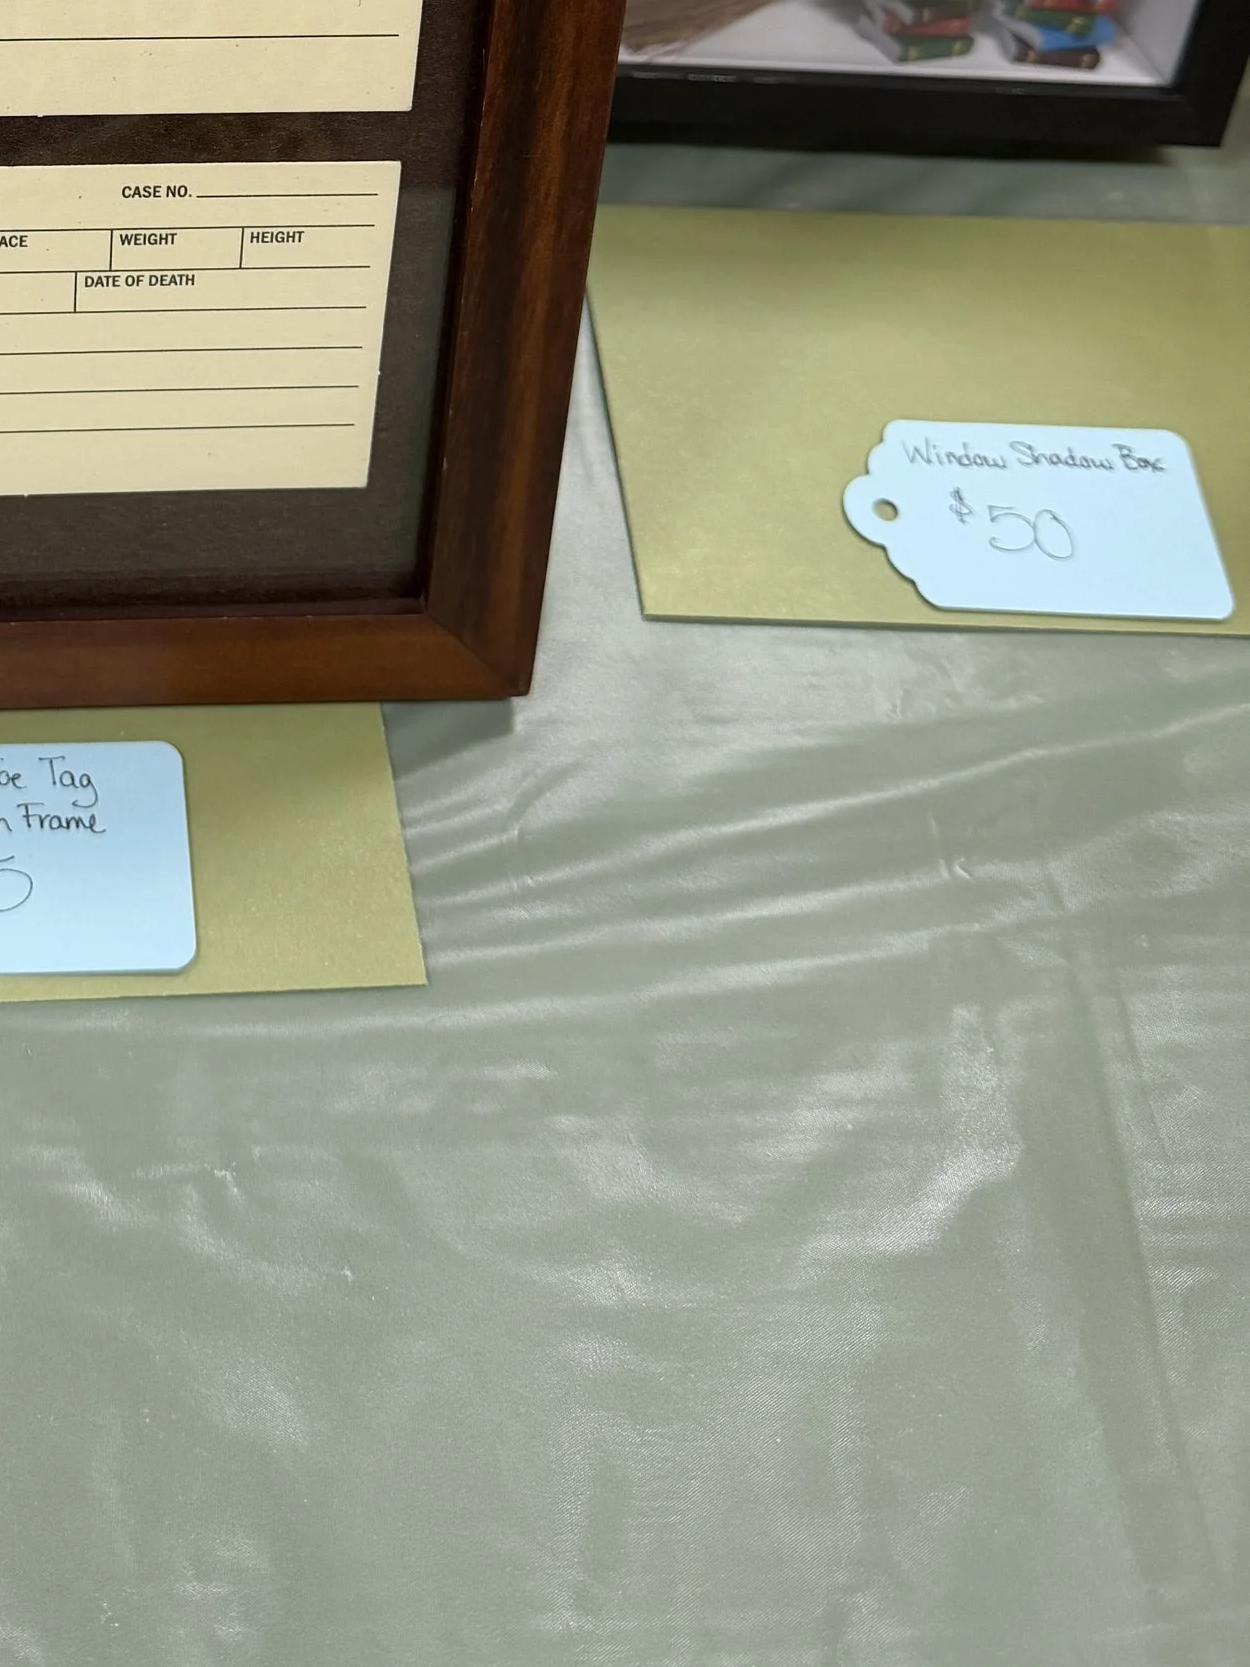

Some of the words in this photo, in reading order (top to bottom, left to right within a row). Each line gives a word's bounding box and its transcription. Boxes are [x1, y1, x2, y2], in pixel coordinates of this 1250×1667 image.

[121, 185, 162, 199] CASE
[165, 184, 192, 198] NO.
[119, 232, 178, 246] WEIGHT
[249, 230, 305, 244] HEIGHT
[84, 275, 121, 288] DATE
[124, 274, 145, 288] OF
[148, 273, 196, 287] DEATH
[38, 756, 98, 808] Tag
[17, 803, 105, 833] Frame
